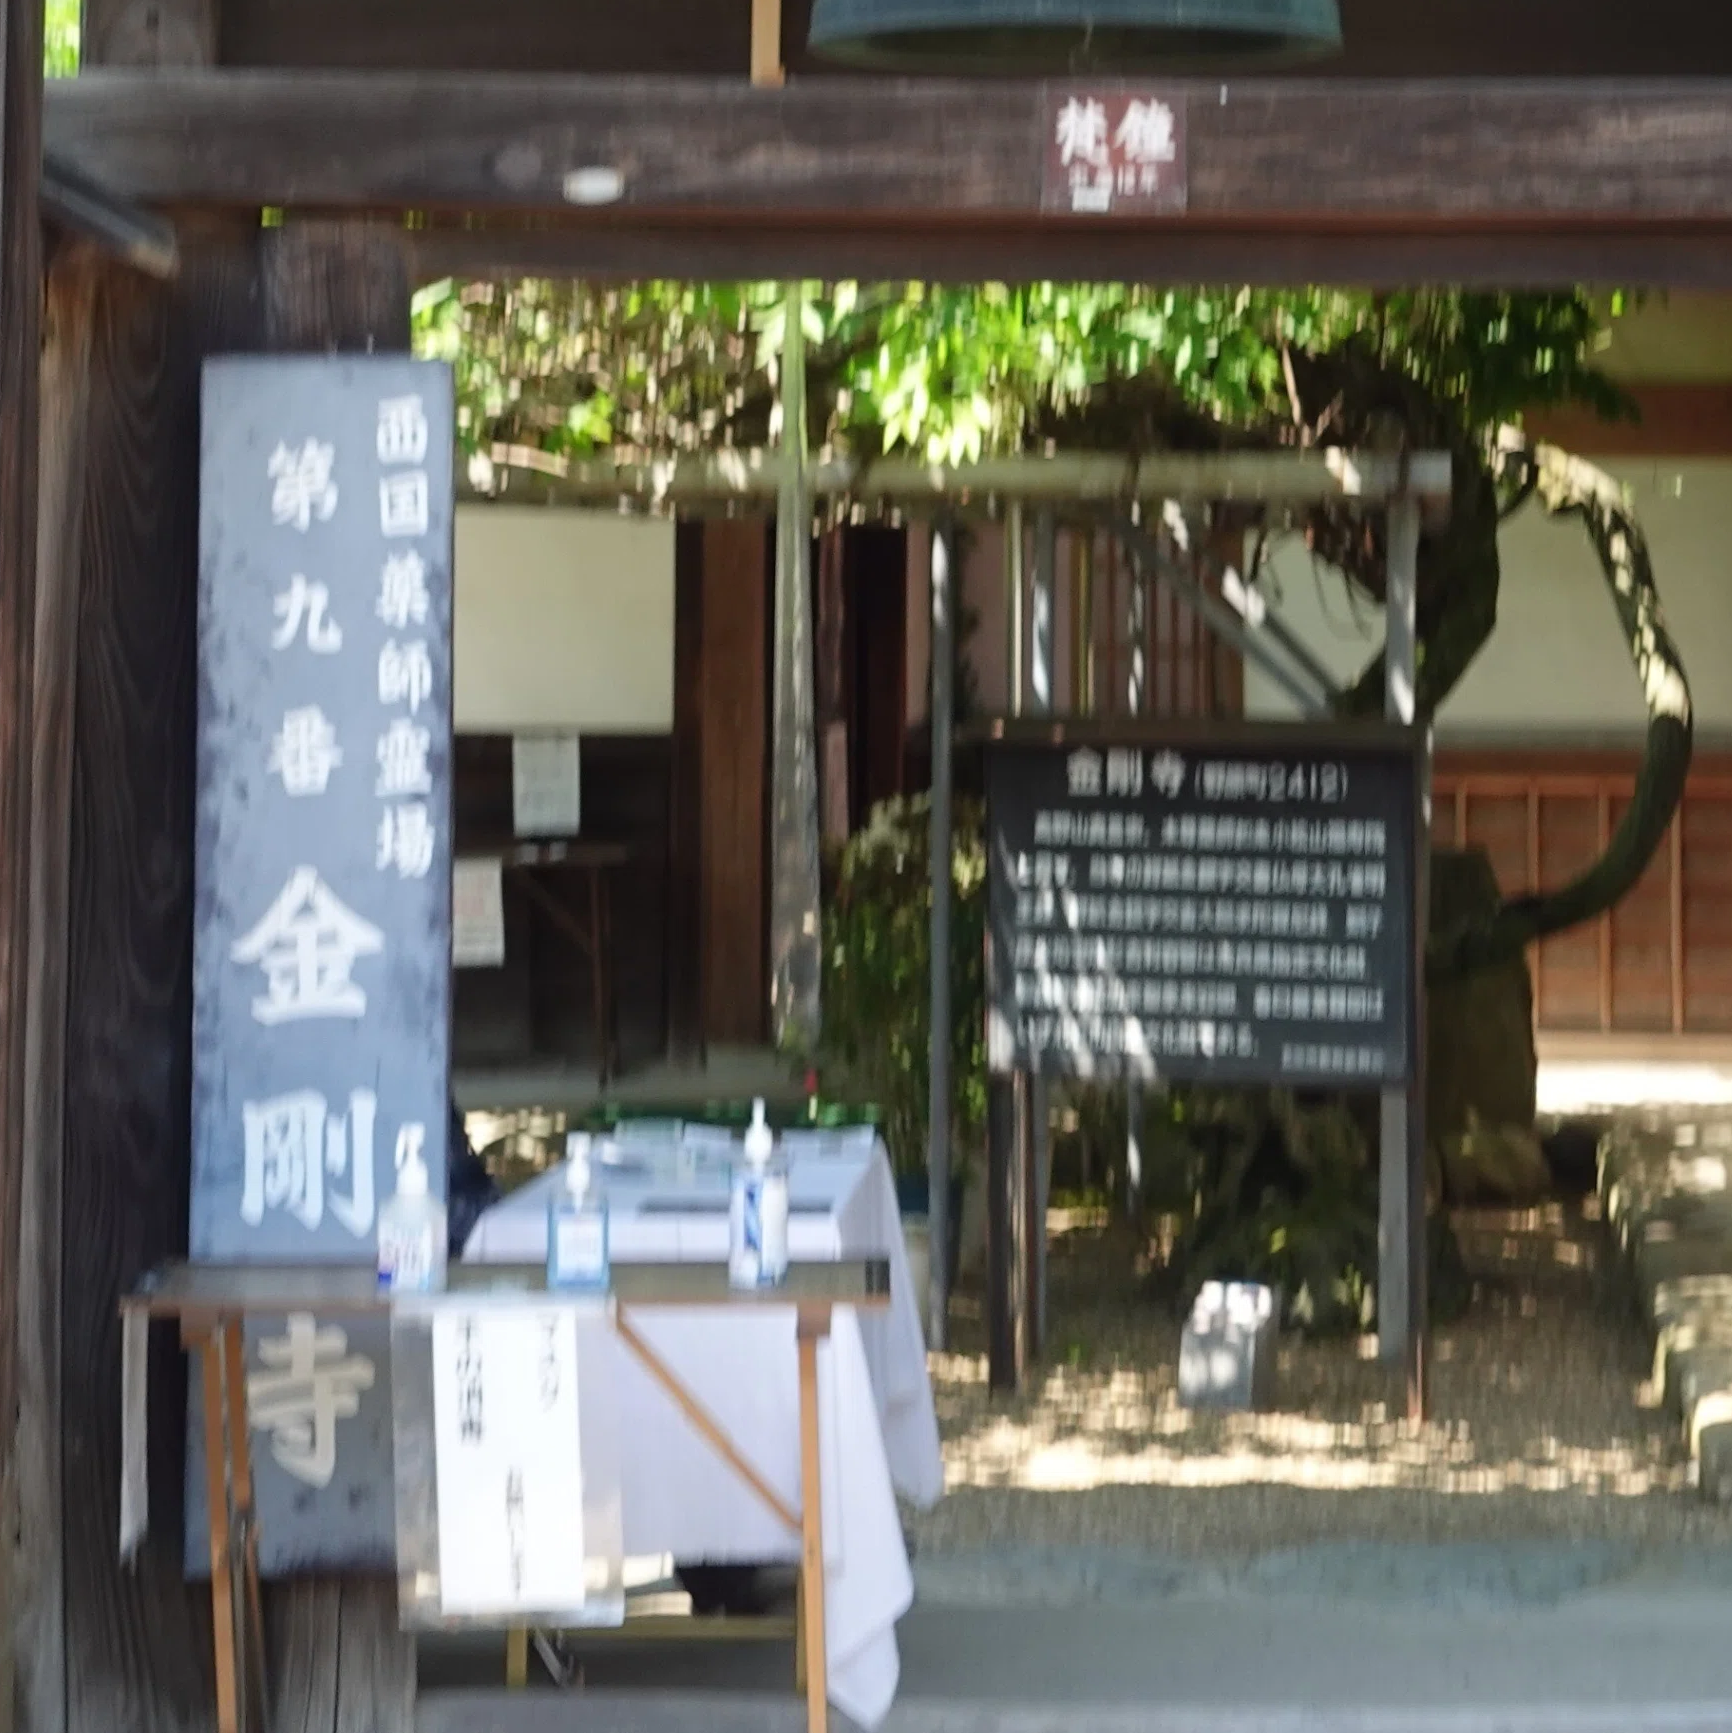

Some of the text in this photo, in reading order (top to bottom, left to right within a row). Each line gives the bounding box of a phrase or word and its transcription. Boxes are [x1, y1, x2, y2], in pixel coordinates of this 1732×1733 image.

[374, 393, 436, 880] 西国薬師霊場
